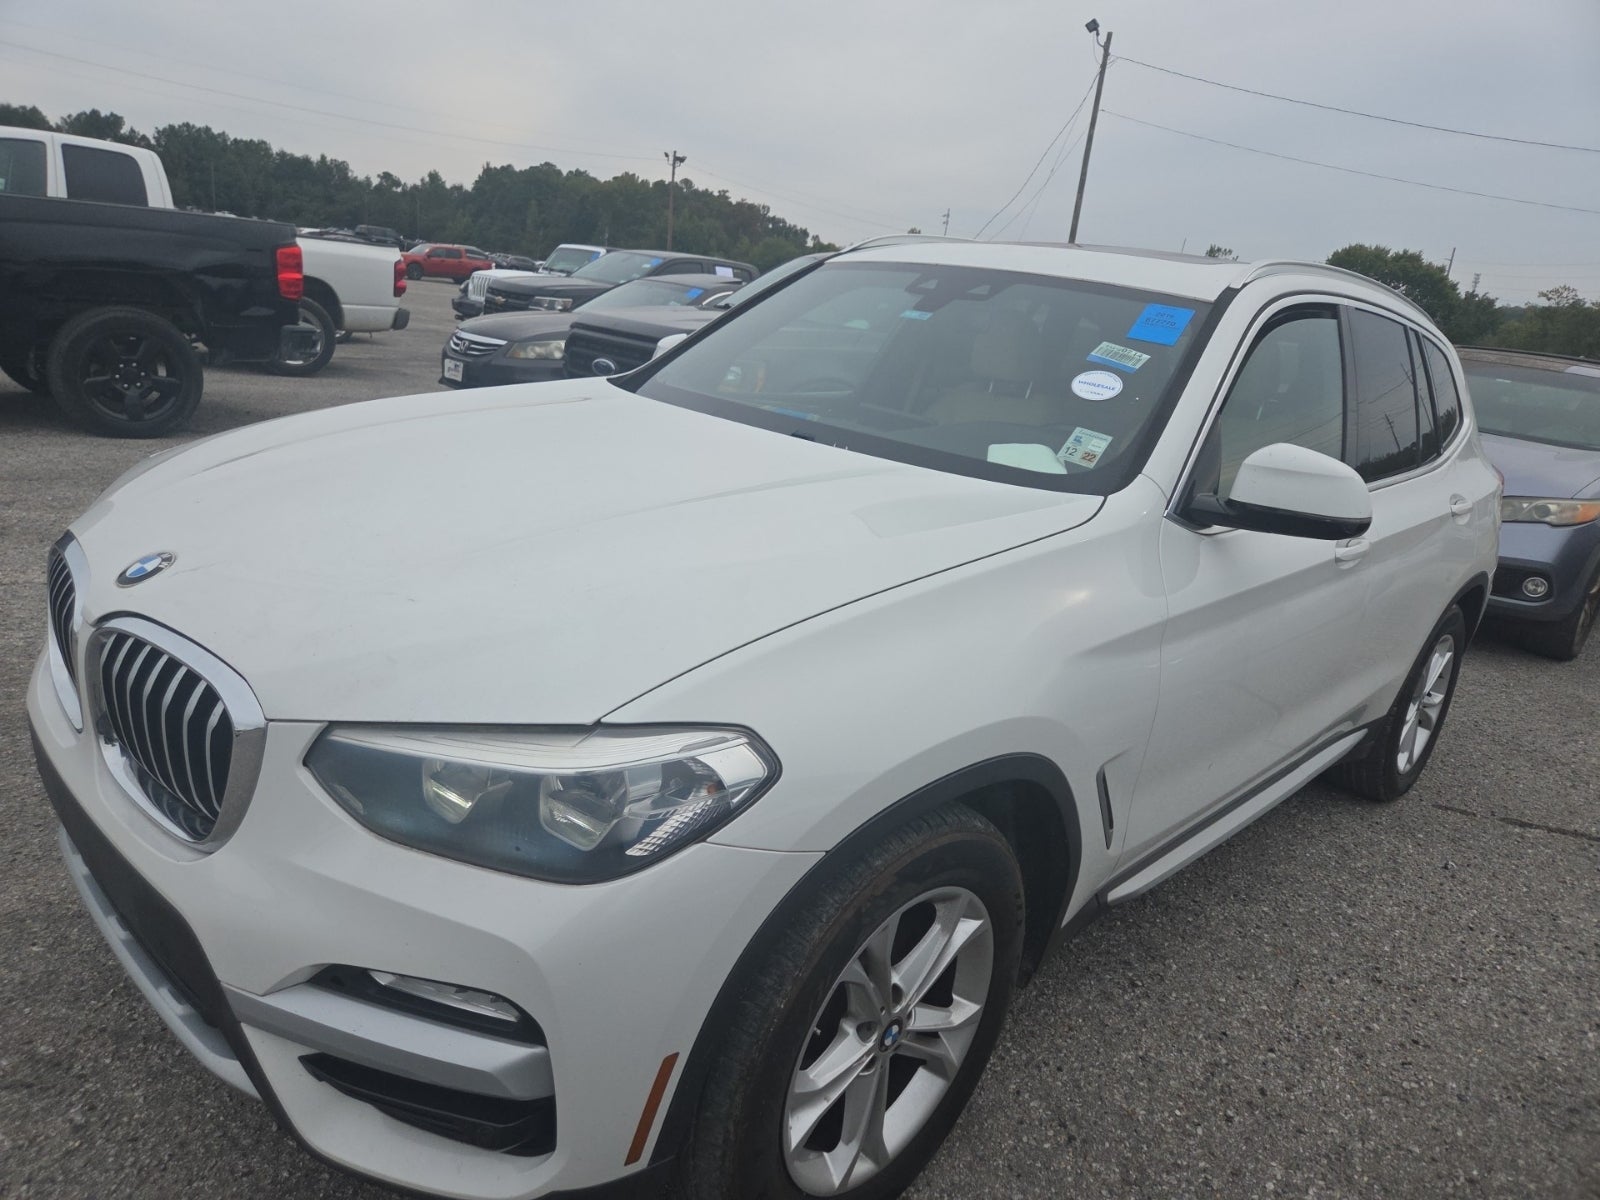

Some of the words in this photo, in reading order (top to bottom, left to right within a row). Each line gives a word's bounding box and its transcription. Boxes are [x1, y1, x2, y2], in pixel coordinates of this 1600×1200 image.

[1078, 379, 1116, 392] WHOLESALE
[1064, 446, 1078, 457] 12
[1081, 452, 1097, 463] 22
